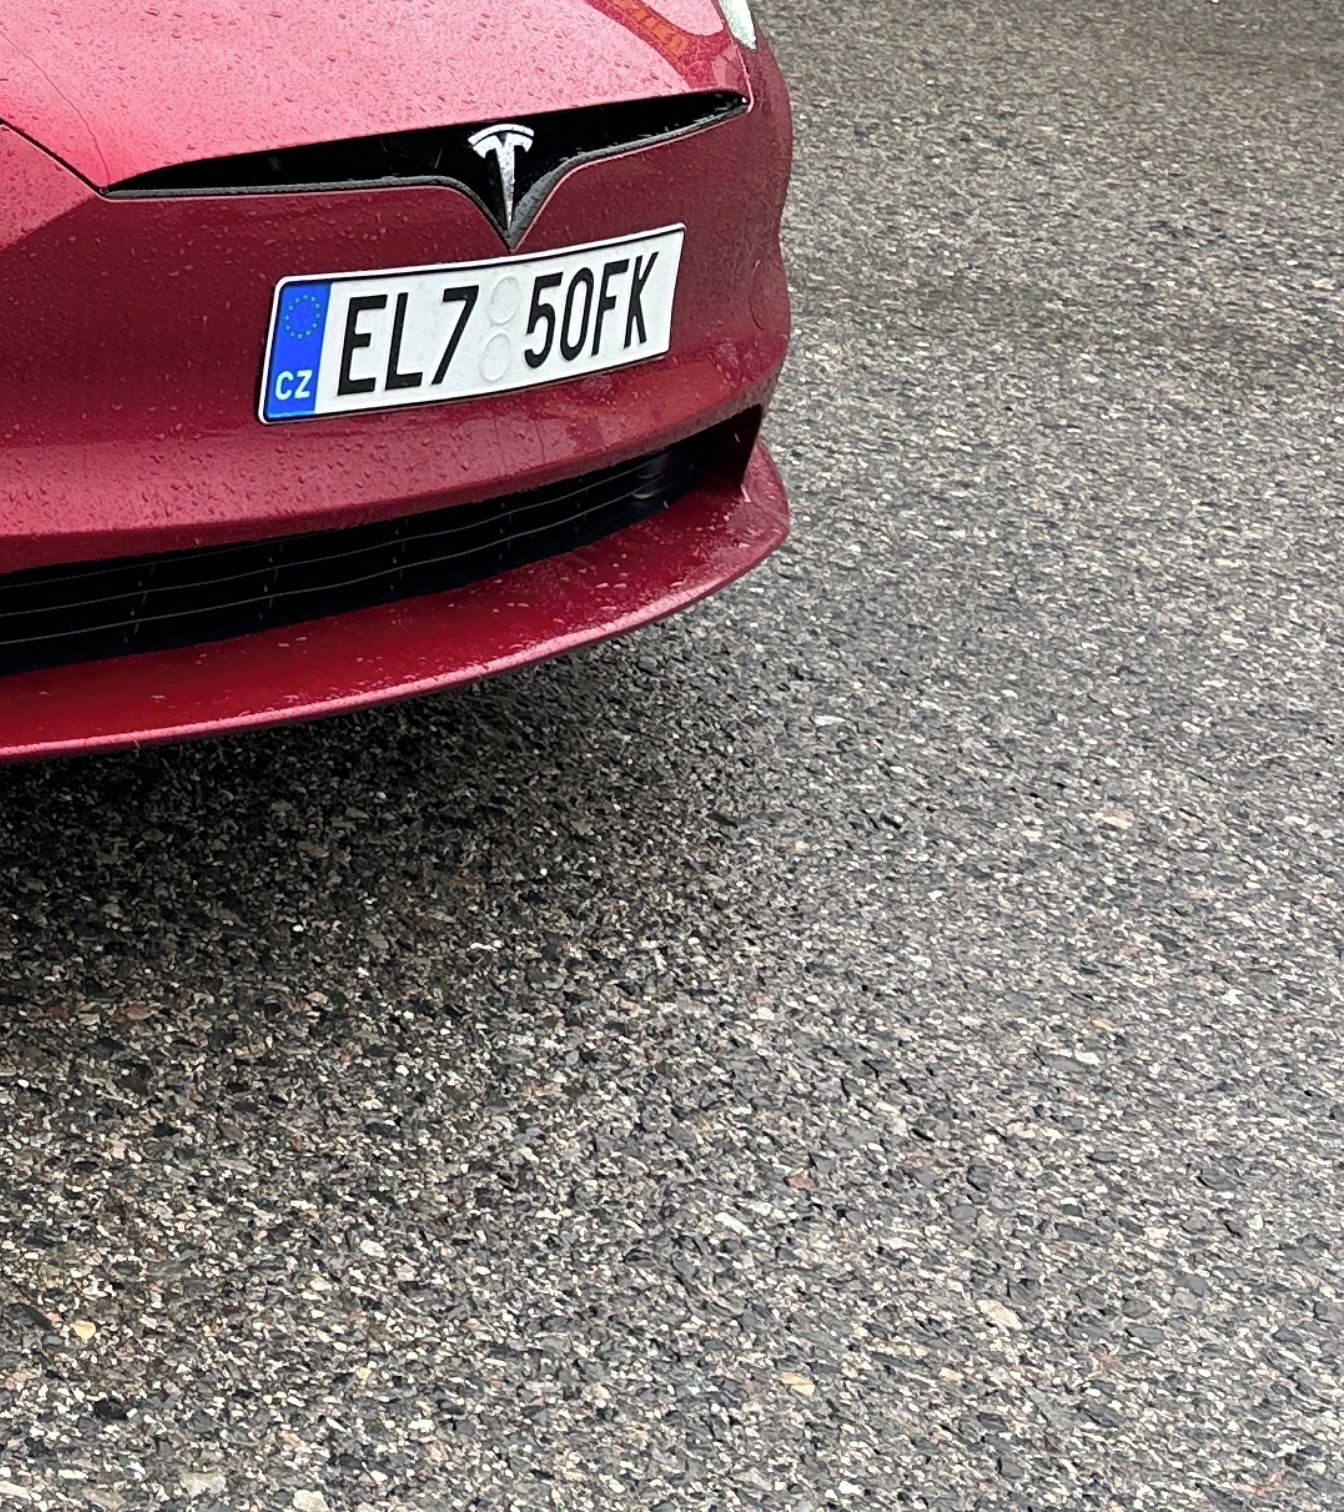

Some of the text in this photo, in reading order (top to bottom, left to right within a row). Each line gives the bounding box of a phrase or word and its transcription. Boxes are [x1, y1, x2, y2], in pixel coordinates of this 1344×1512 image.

[337, 251, 660, 397] EL7 50FK
[275, 369, 312, 400] CZ
